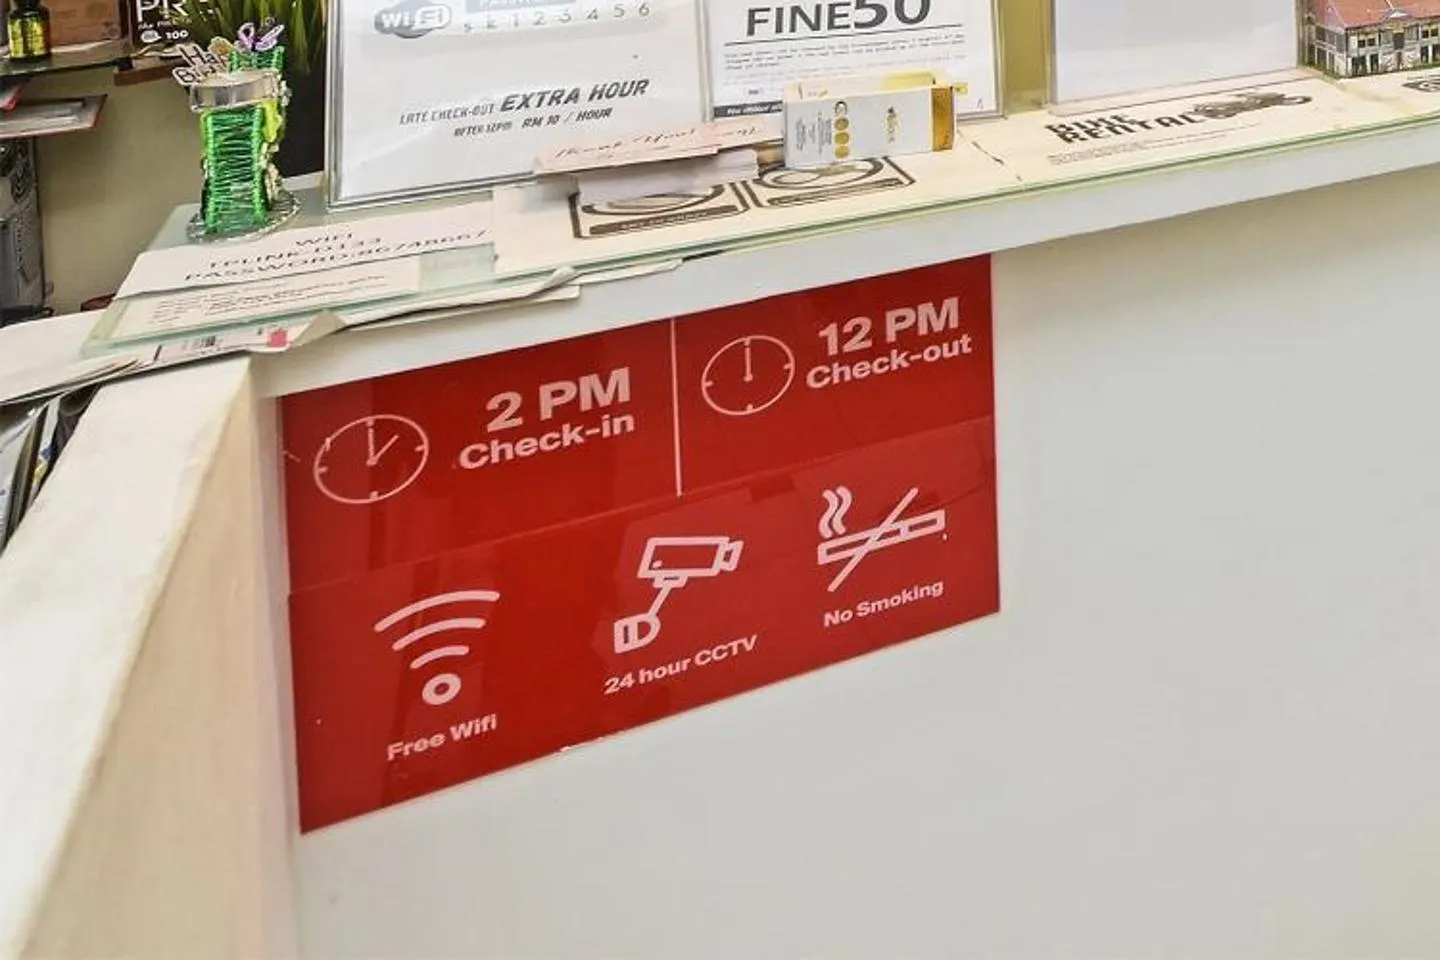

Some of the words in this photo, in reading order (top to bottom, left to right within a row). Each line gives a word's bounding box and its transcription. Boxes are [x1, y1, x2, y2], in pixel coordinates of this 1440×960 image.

[746, 1, 852, 37] FINE
[500, 87, 581, 112] EXTRA
[587, 78, 650, 103] HOUR
[575, 107, 614, 122] HOUR
[817, 315, 873, 357] 12
[884, 296, 960, 343] PM
[804, 332, 973, 391] Check-out
[484, 391, 524, 432] 2
[537, 367, 632, 422] PM
[457, 412, 635, 471] Check-in
[822, 608, 854, 629] No
[855, 579, 945, 621] Smoking
[603, 673, 636, 696] 24
[638, 655, 692, 685] hour
[693, 633, 758, 668] CCTV
[386, 731, 445, 763] Free
[448, 712, 498, 743] Wifi
